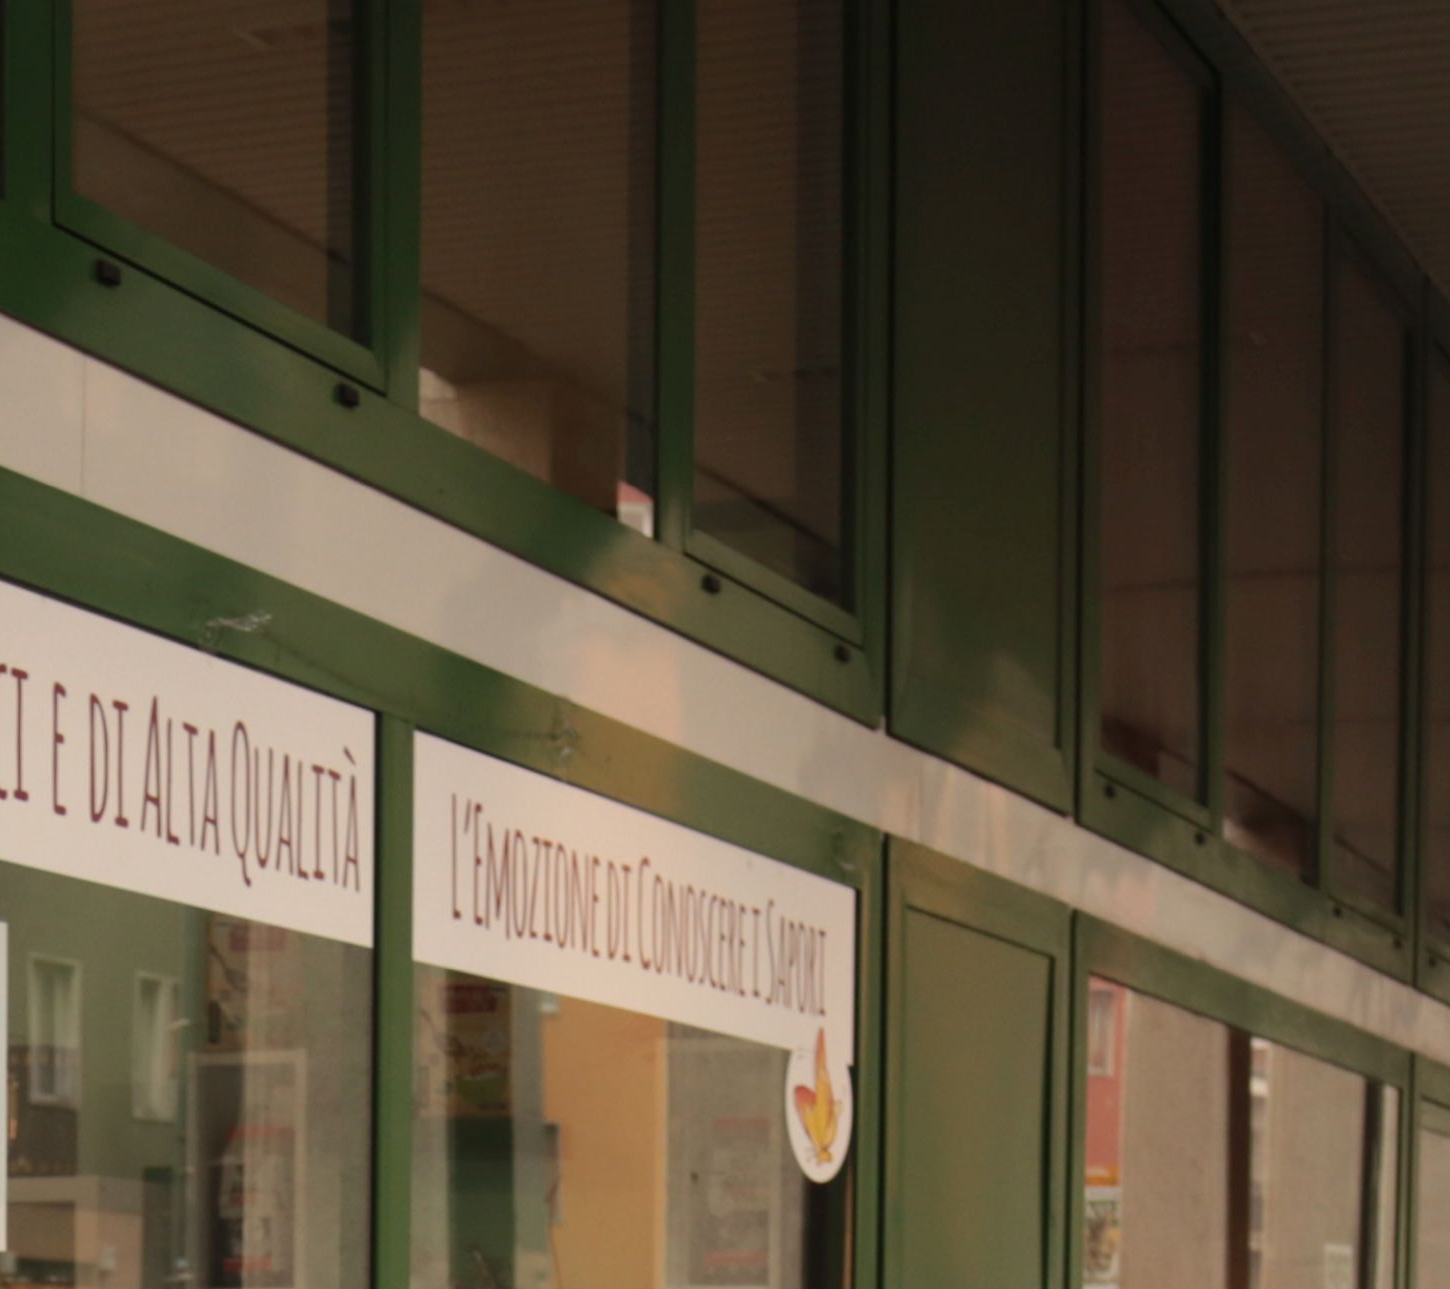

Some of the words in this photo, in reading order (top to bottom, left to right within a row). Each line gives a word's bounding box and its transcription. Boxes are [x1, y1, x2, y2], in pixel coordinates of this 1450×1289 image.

[141, 695, 219, 855] ALTA
[230, 721, 360, 892] QUALITÀ
[638, 857, 746, 997] CONOSCERE
[766, 899, 826, 1015] SAPORI
